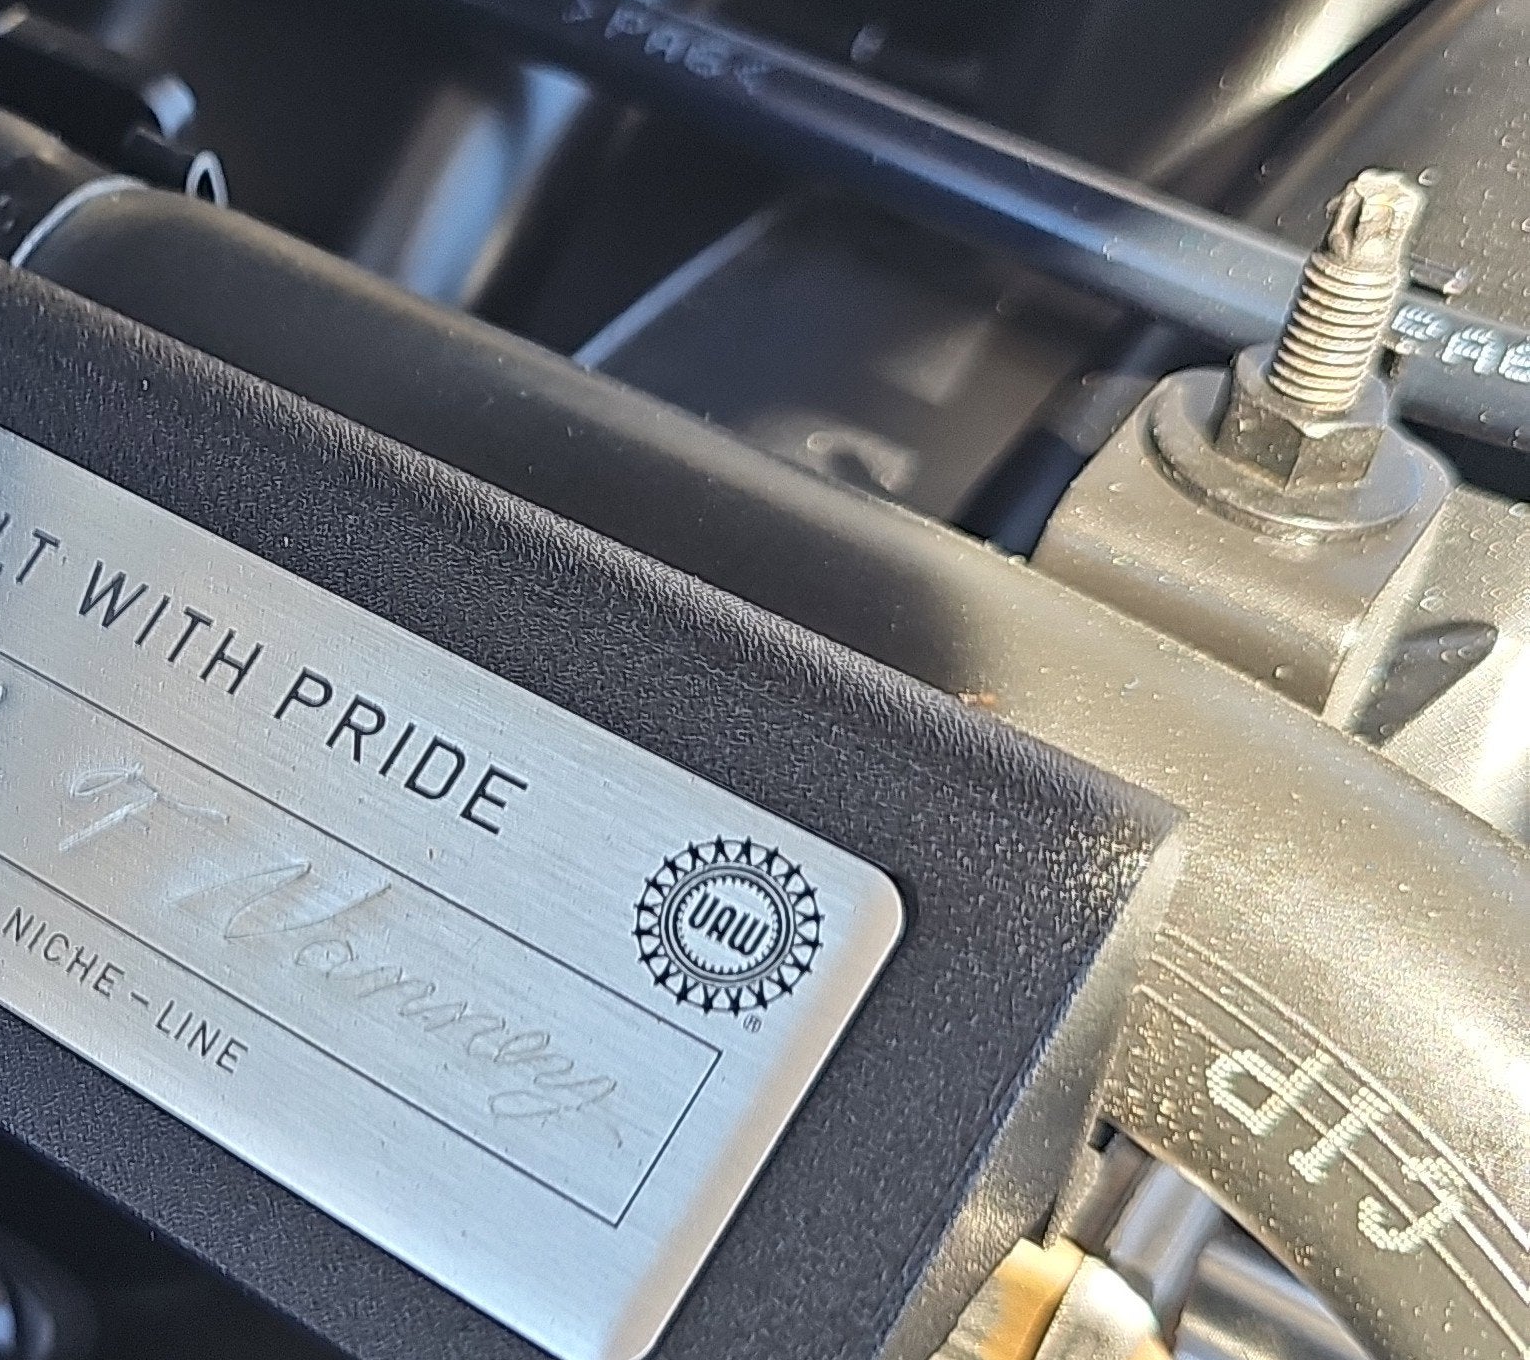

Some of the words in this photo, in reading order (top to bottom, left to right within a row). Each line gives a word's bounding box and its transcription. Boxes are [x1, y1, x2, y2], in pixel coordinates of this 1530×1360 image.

[75, 566, 266, 696] WITH
[273, 667, 529, 835] PRIDE
[688, 891, 770, 954] UAW
